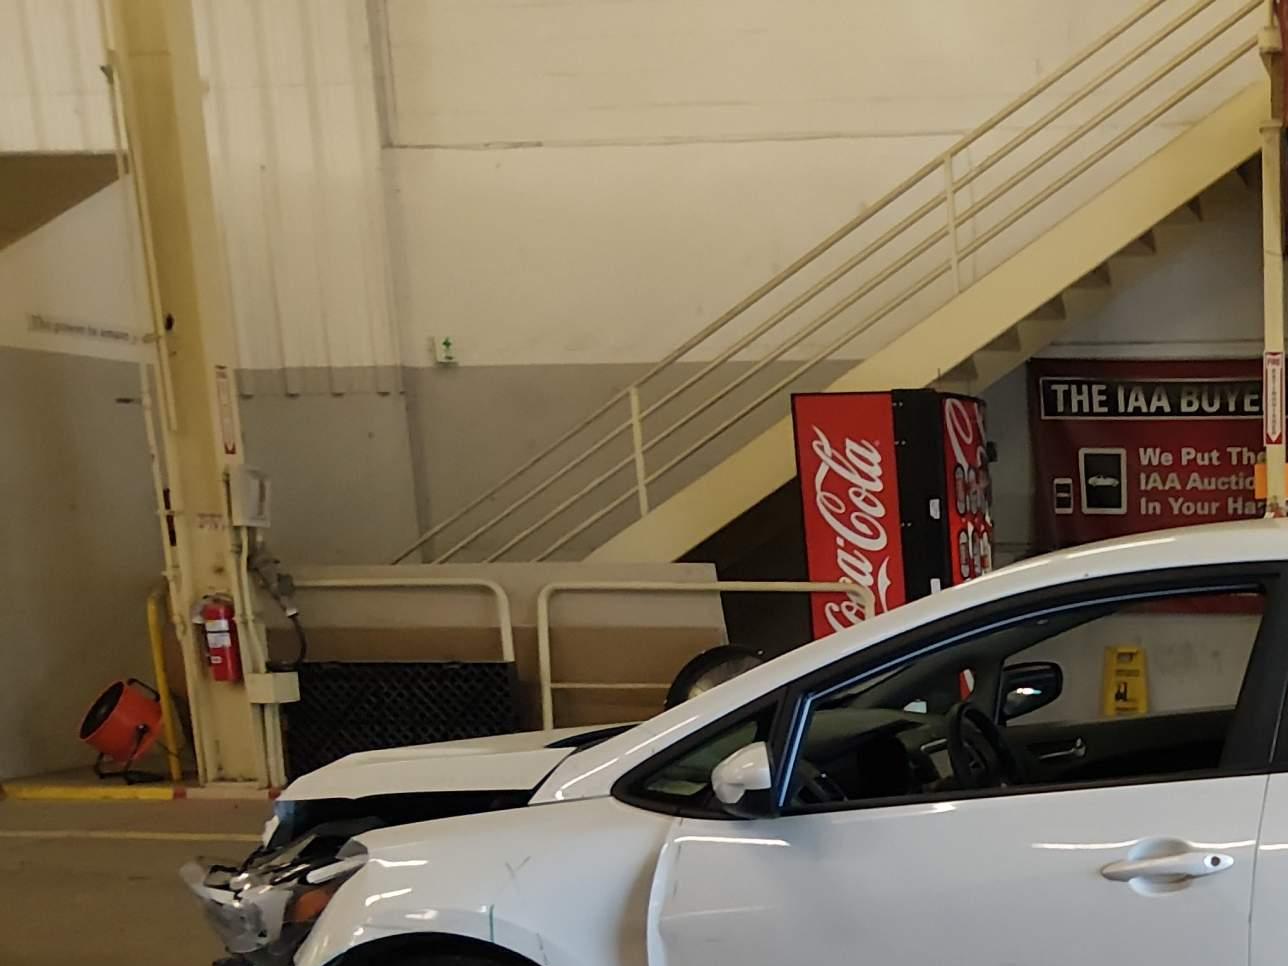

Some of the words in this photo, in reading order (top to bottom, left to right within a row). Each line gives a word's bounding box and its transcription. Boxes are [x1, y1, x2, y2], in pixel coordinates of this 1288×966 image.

[1052, 384, 1108, 414] THE
[1118, 384, 1171, 414] IAA
[1180, 383, 1261, 413] BUYE
[1139, 447, 1174, 466] We
[1181, 447, 1221, 466] Put
[1139, 472, 1181, 491] IAA
[1186, 472, 1256, 490] Auctio
[1140, 498, 1161, 515] In
[1168, 497, 1221, 515] Your
